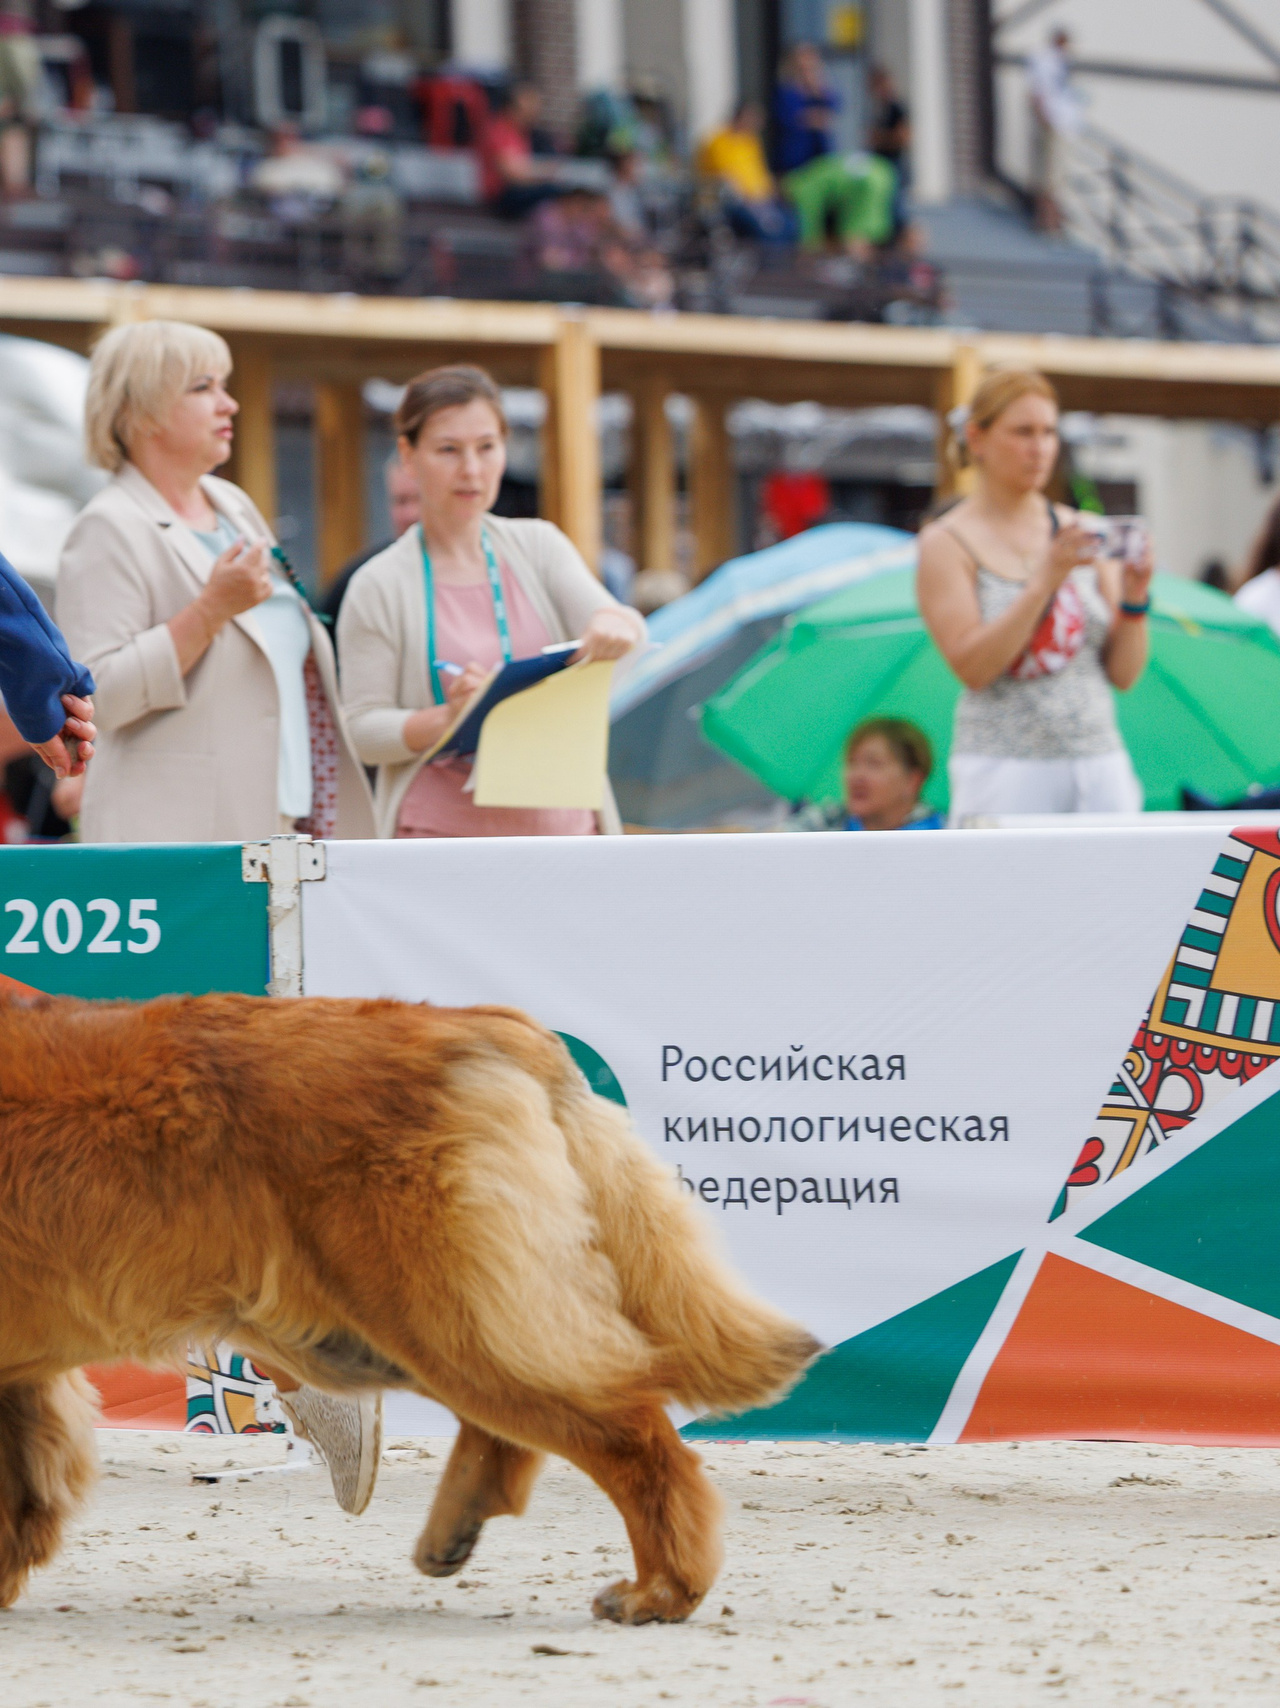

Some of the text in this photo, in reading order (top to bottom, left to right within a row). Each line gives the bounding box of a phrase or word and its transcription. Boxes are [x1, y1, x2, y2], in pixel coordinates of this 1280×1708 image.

[5, 898, 161, 954] 2025
[661, 1044, 907, 1082] Российская
[663, 1113, 1010, 1143] кинологическая
